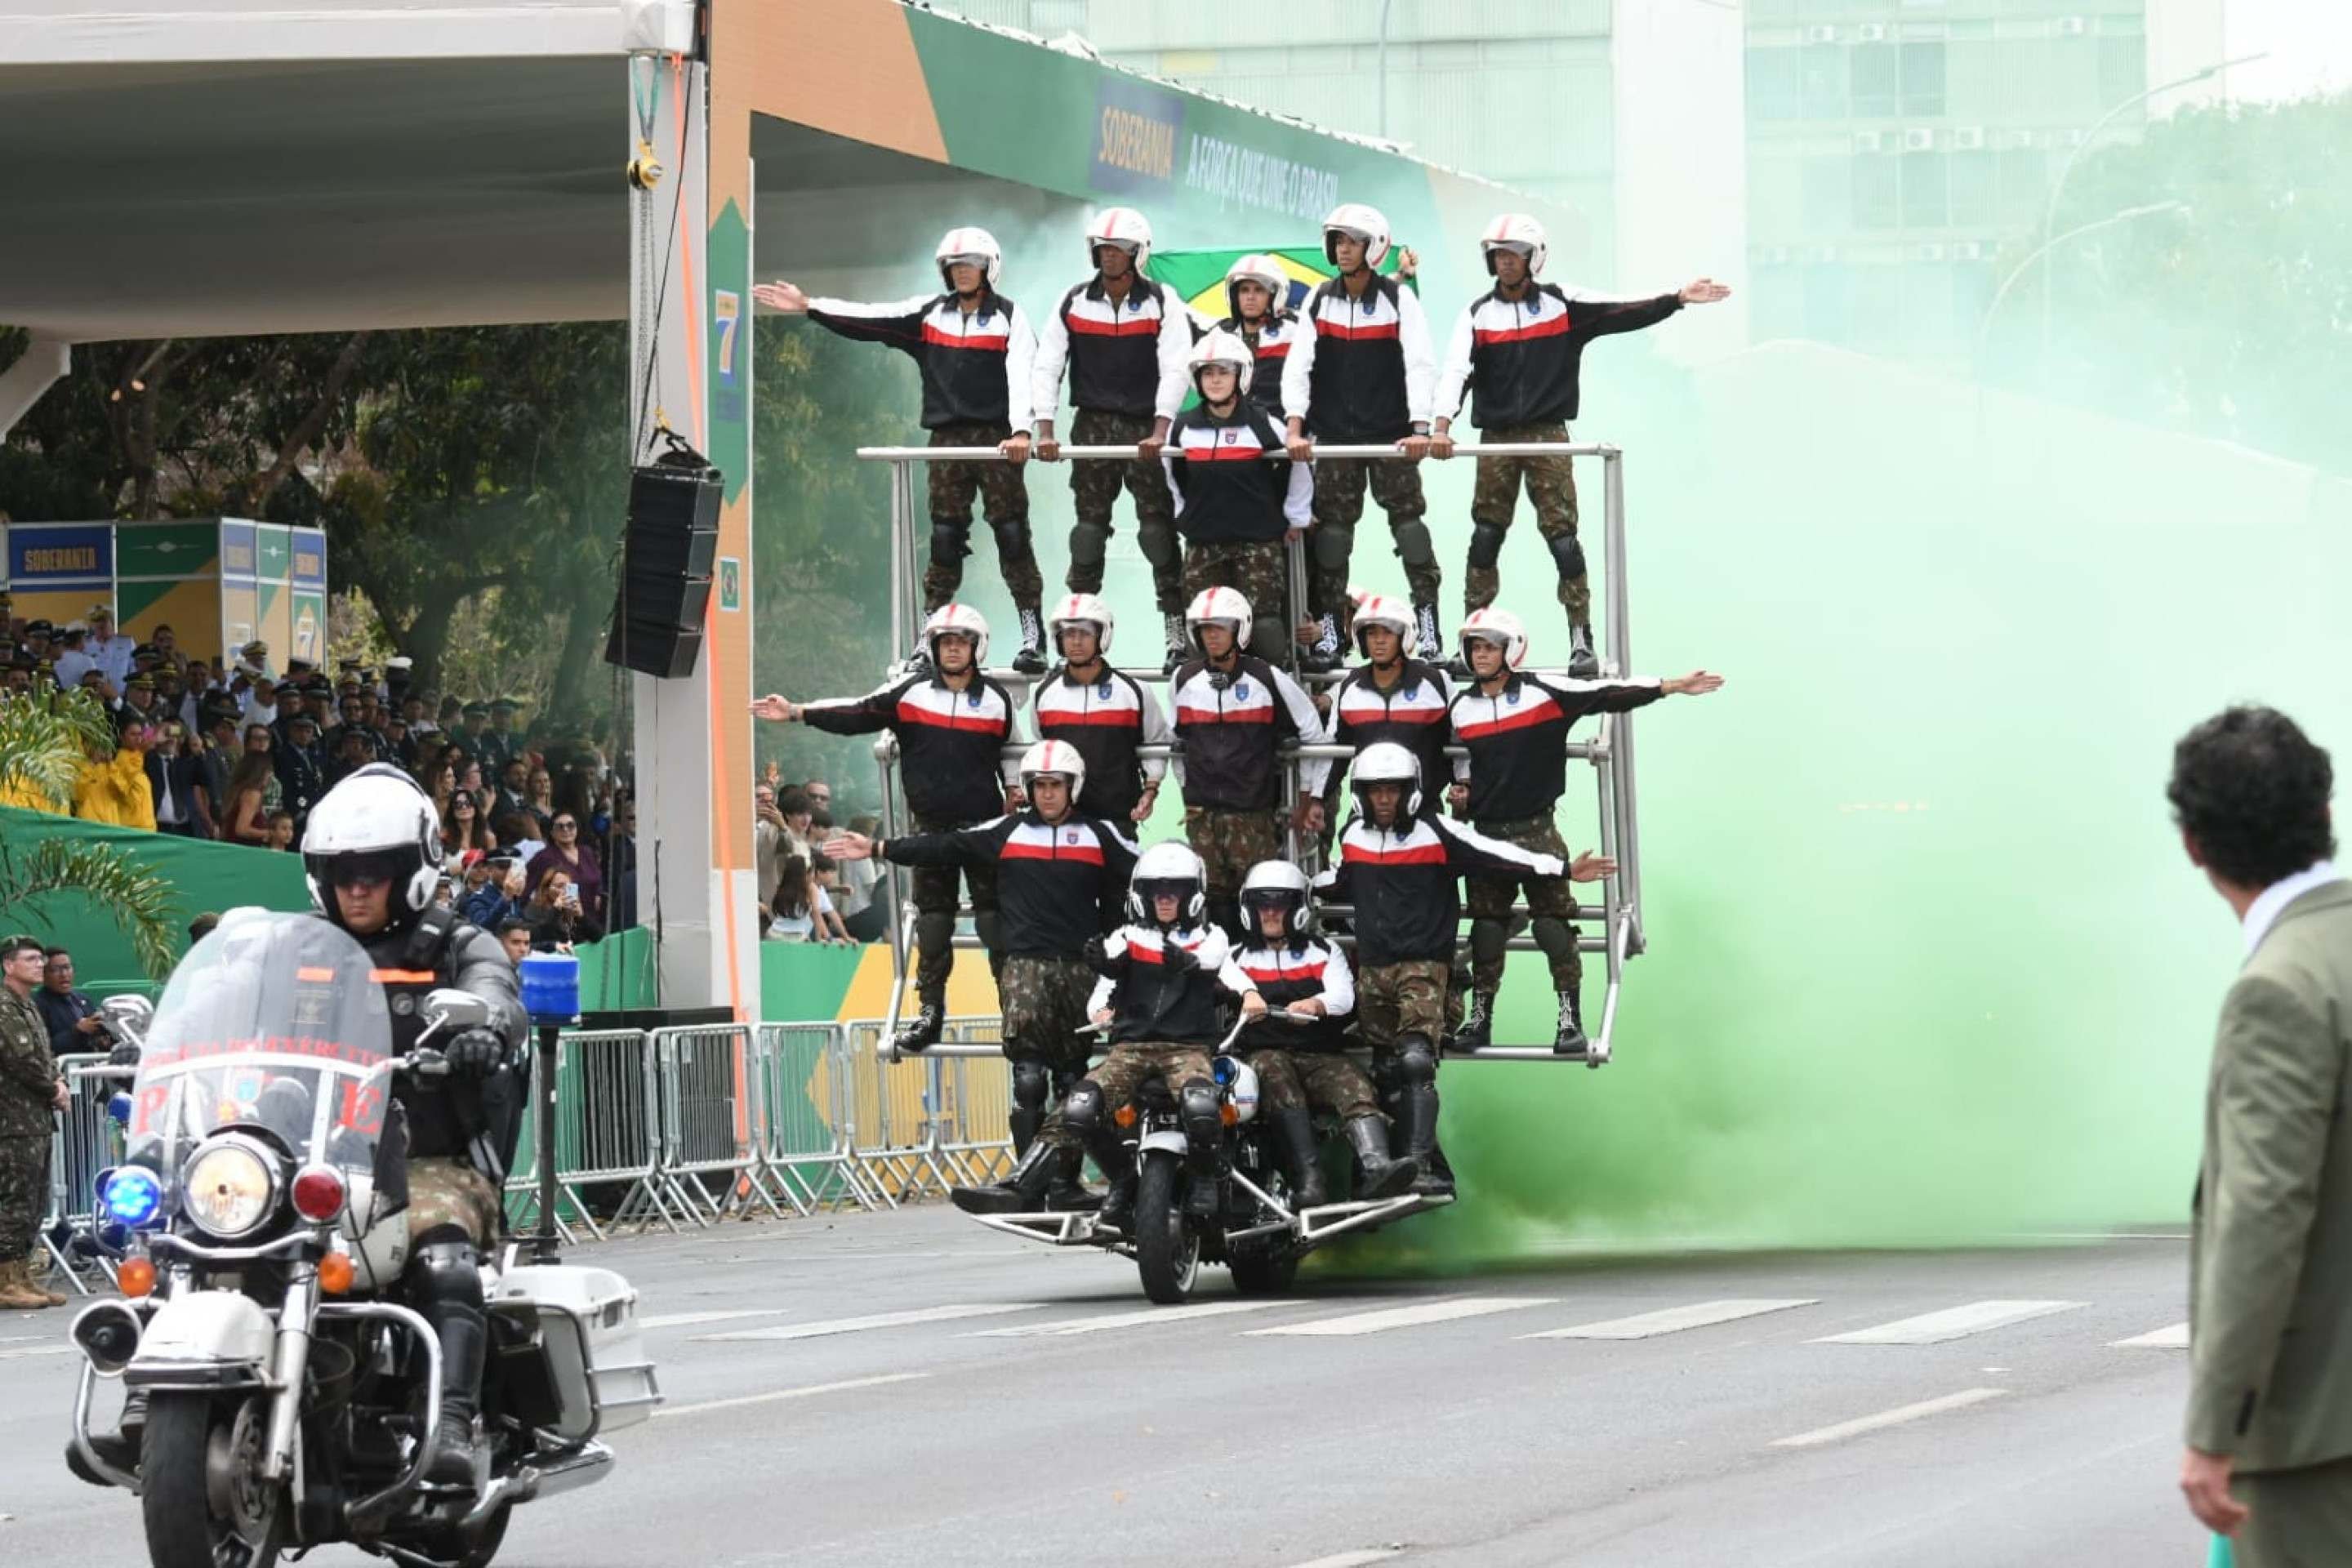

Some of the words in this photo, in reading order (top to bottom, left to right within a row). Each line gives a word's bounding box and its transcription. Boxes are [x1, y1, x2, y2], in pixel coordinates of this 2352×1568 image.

[1098, 105, 1174, 179] SOBERANIA
[1186, 133, 1201, 188] A
[1236, 147, 1265, 212] QUE
[135, 1086, 169, 1136] P
[336, 1080, 382, 1134] E
